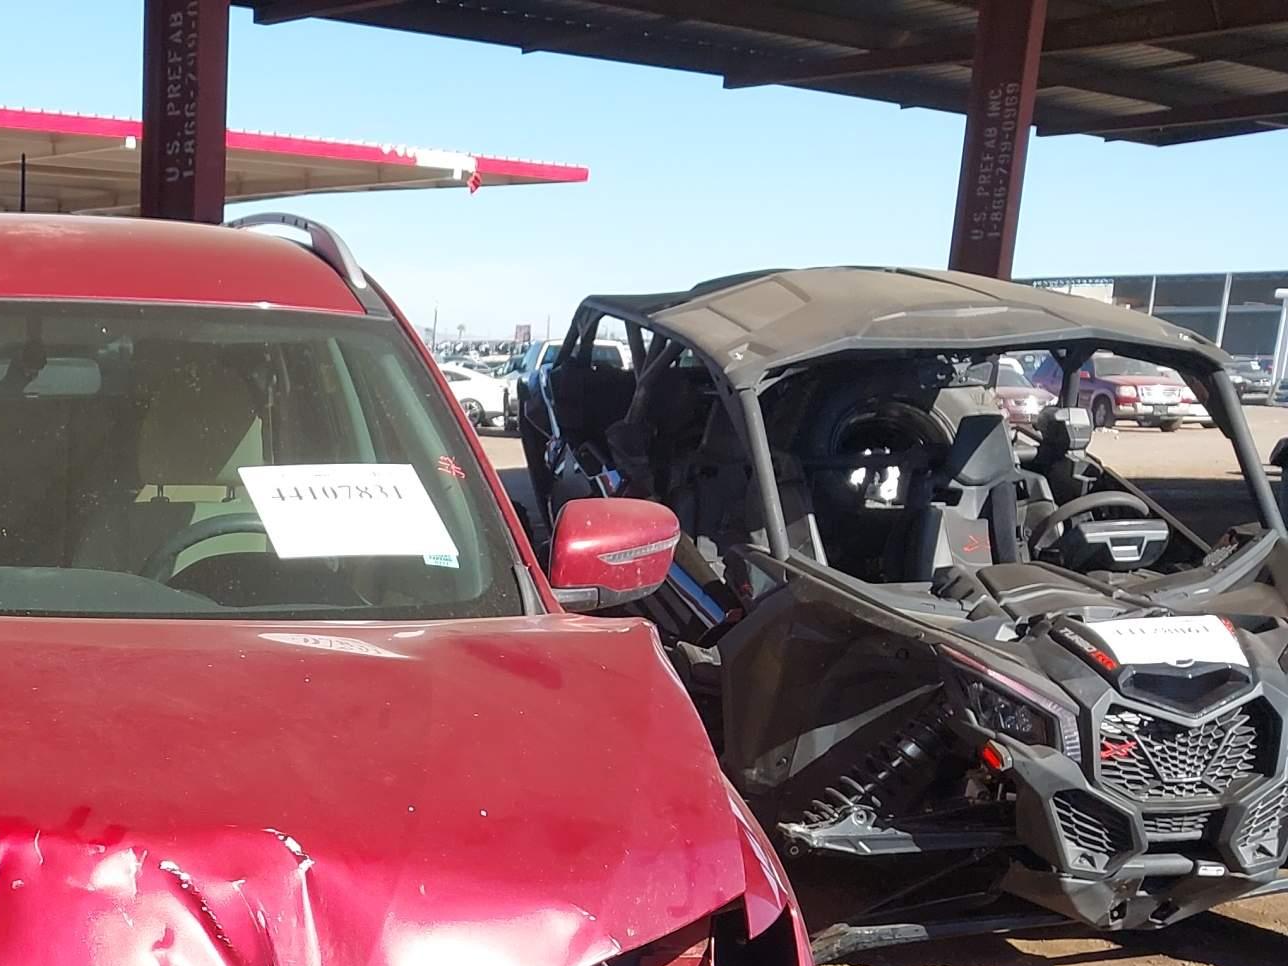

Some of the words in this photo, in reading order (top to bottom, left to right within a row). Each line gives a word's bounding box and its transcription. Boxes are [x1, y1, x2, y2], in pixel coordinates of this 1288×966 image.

[167, 11, 183, 116] PREFAB
[989, 82, 1004, 118] INC.
[165, 131, 181, 182] U.S.
[976, 127, 998, 197] PREFAB
[971, 205, 988, 241] U.S.
